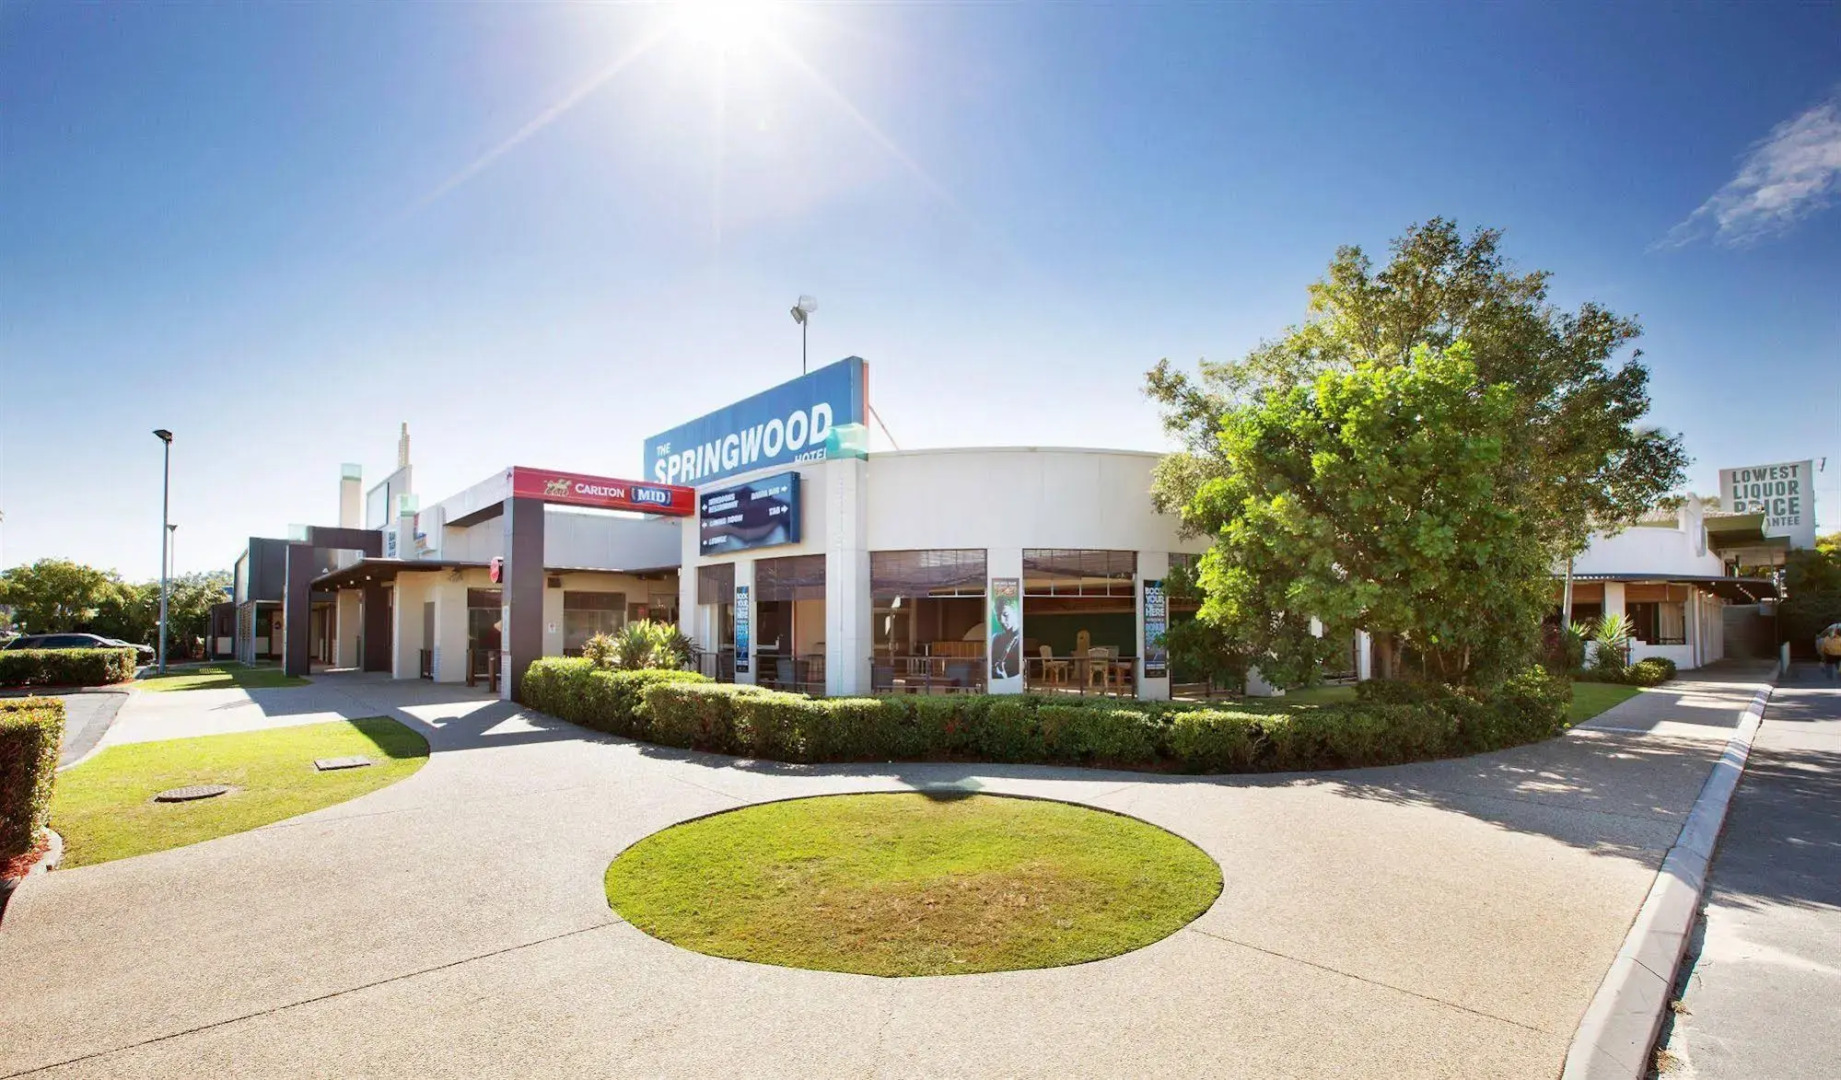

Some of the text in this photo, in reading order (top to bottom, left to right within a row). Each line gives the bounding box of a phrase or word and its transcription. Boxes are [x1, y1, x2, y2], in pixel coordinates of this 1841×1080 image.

[654, 402, 833, 485] SPRINGWOOD
[656, 442, 670, 456] THE
[1732, 465, 1798, 483] LOWEST
[575, 483, 666, 503] CARLTON MID
[1733, 480, 1799, 499] LIQUOR
[1733, 497, 1800, 516] PICE
